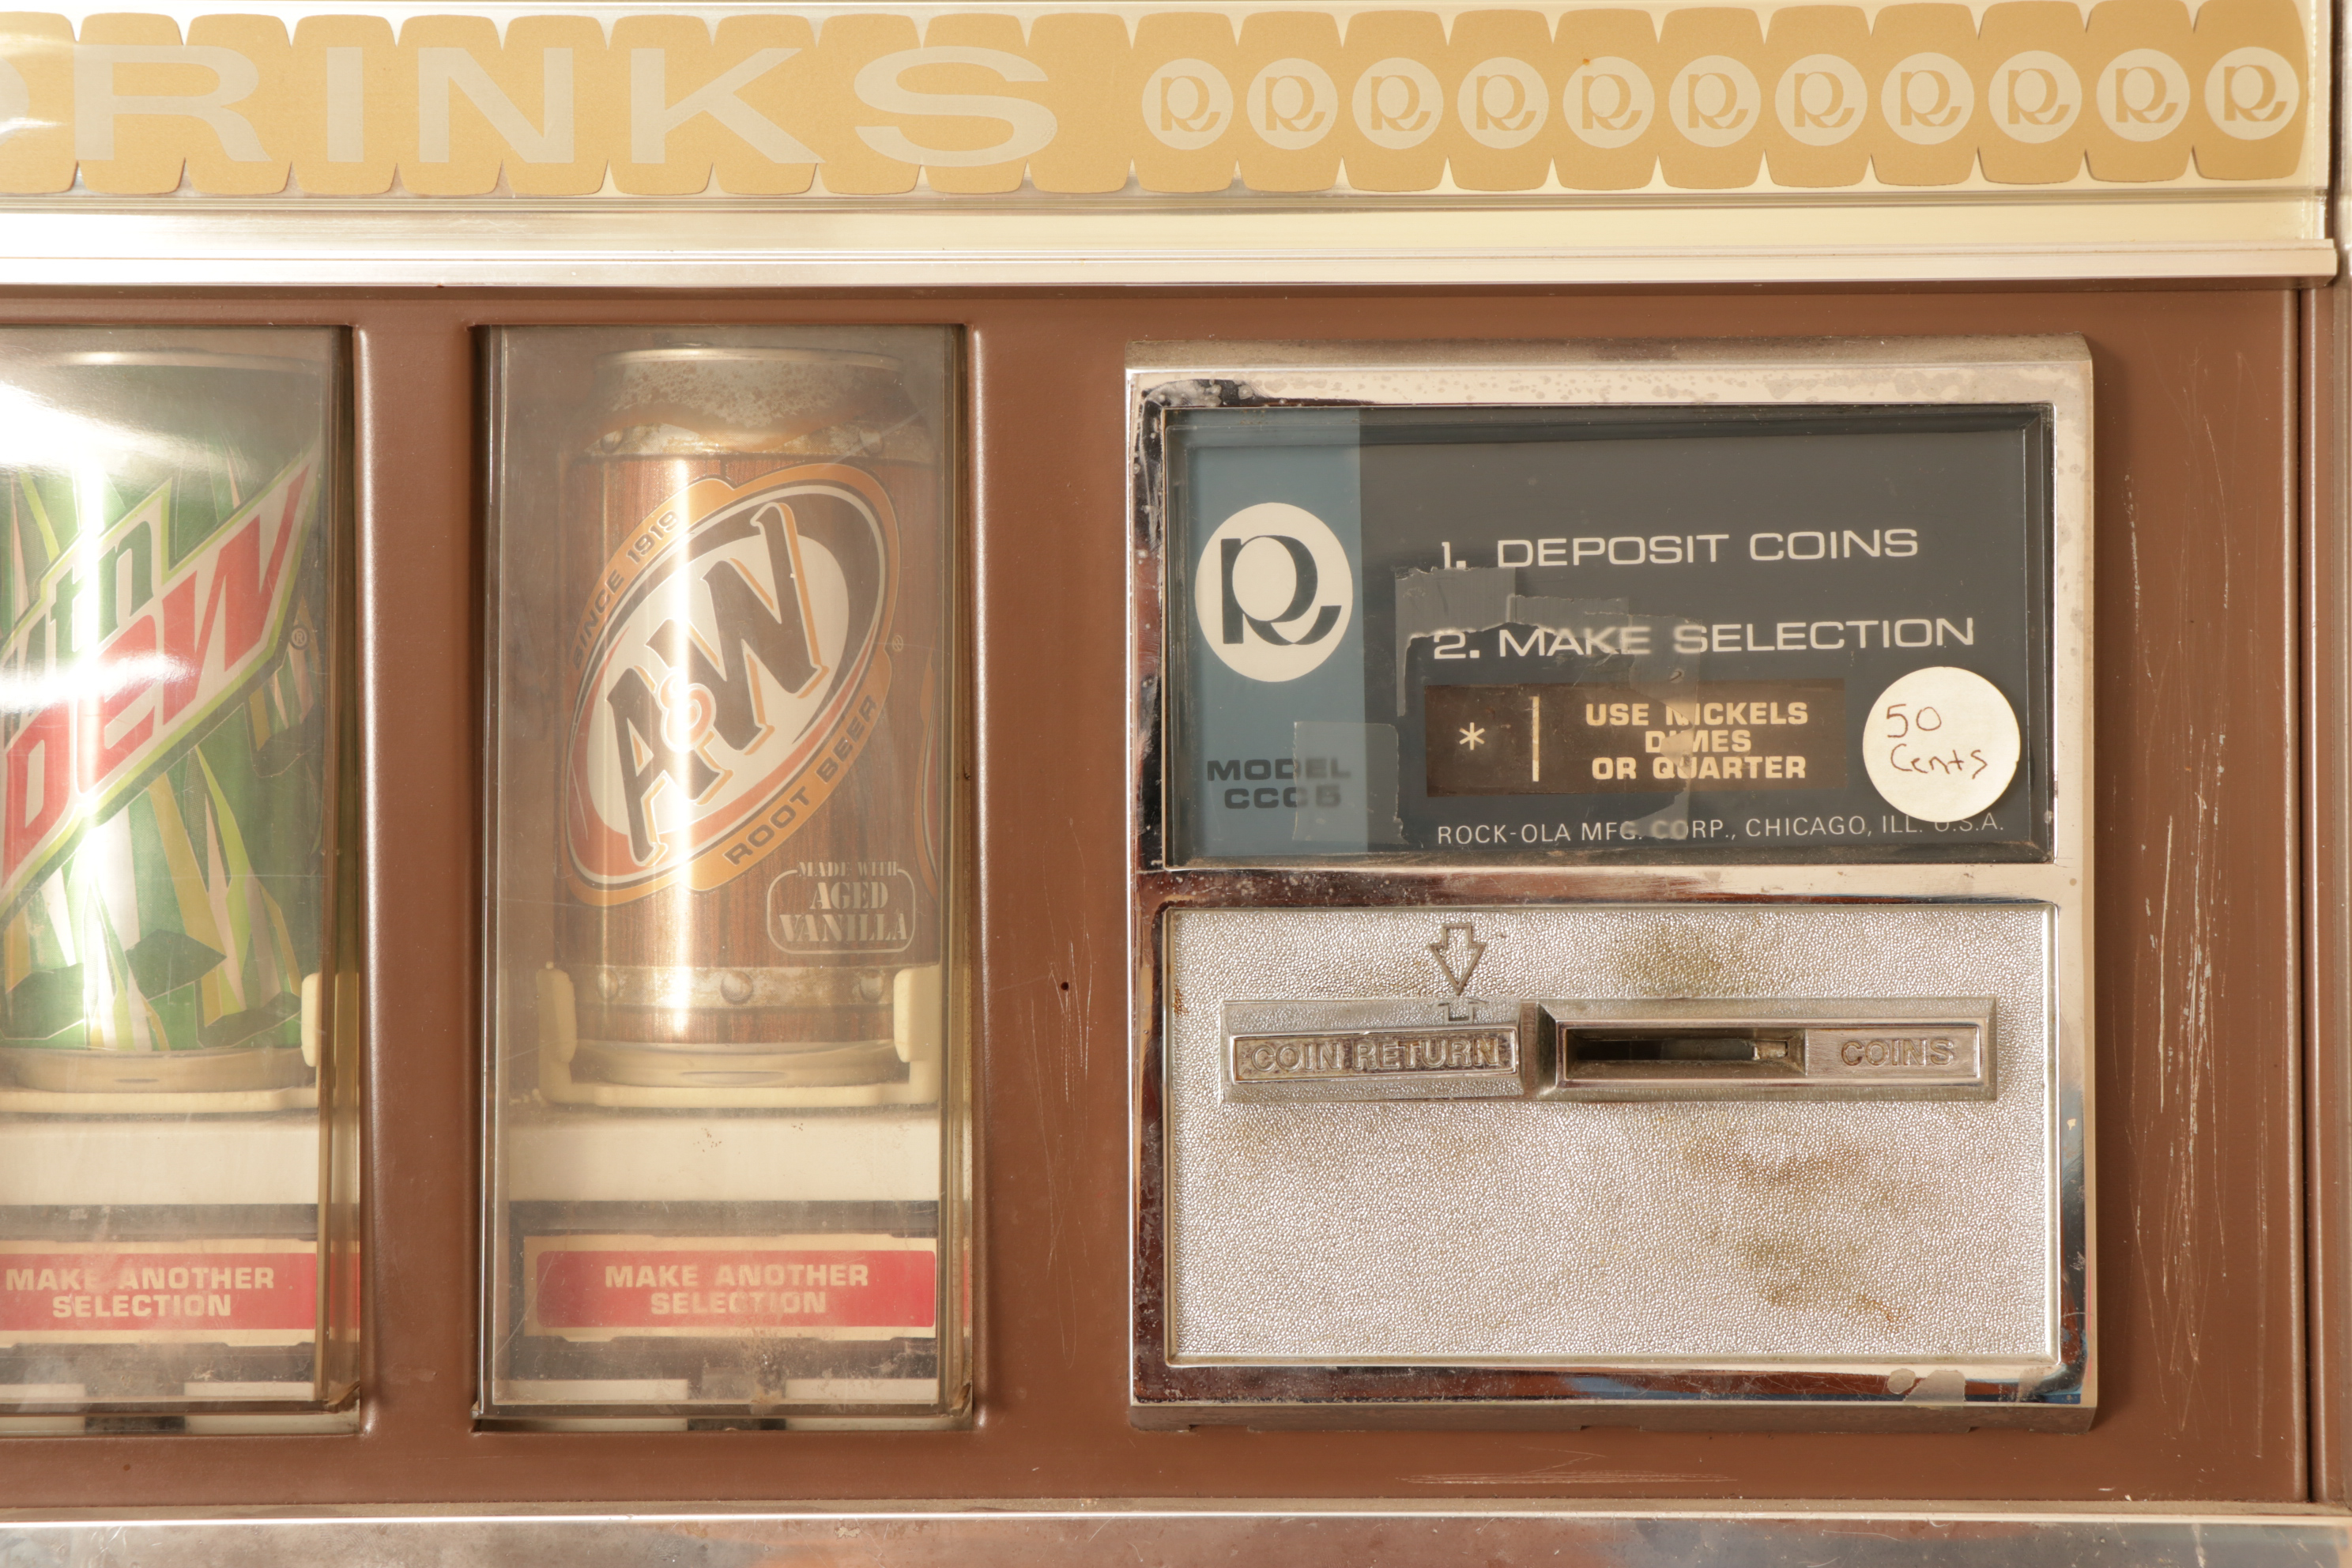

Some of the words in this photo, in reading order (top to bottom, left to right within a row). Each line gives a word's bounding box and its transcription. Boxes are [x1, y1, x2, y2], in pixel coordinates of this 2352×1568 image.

[0, 44, 1058, 167] RINKS
[626, 510, 680, 564] 1919
[1441, 541, 1467, 569] 1.
[1496, 533, 1729, 568] DEPOSIT
[1749, 529, 1919, 561] COINS
[1433, 631, 1480, 660] 2.
[1498, 625, 1652, 658] MAKE
[1672, 617, 1974, 654] SELECTION
[1585, 703, 1649, 726] USE
[1886, 703, 1942, 738] 50
[1645, 729, 1752, 752] DMES
[722, 786, 810, 867] ROOT
[814, 694, 877, 784] BEER
[1207, 756, 1351, 782] MODEL
[1592, 756, 1638, 780] OR
[1652, 755, 1807, 779] QUARTER
[1437, 823, 1572, 845] ROCK-OLA
[1581, 820, 1642, 841] MFG.
[1745, 816, 1873, 838] CHICAGO,
[1883, 814, 1923, 834] ILL.
[798, 861, 851, 877] MADE
[857, 861, 898, 876] WITH
[808, 881, 889, 910] AGED
[778, 912, 908, 942] VANILLA
[1250, 1042, 1342, 1072] COIN
[1353, 1037, 1499, 1069] RETURN
[1841, 1038, 1954, 1067] COINS
[6, 1268, 98, 1291] MAKE
[118, 1266, 275, 1291] ANOTHER
[605, 1265, 698, 1288] MAKE
[714, 1264, 869, 1287] ANOTHER
[52, 1294, 232, 1318] SELECTION
[650, 1291, 827, 1315] SELECTION
